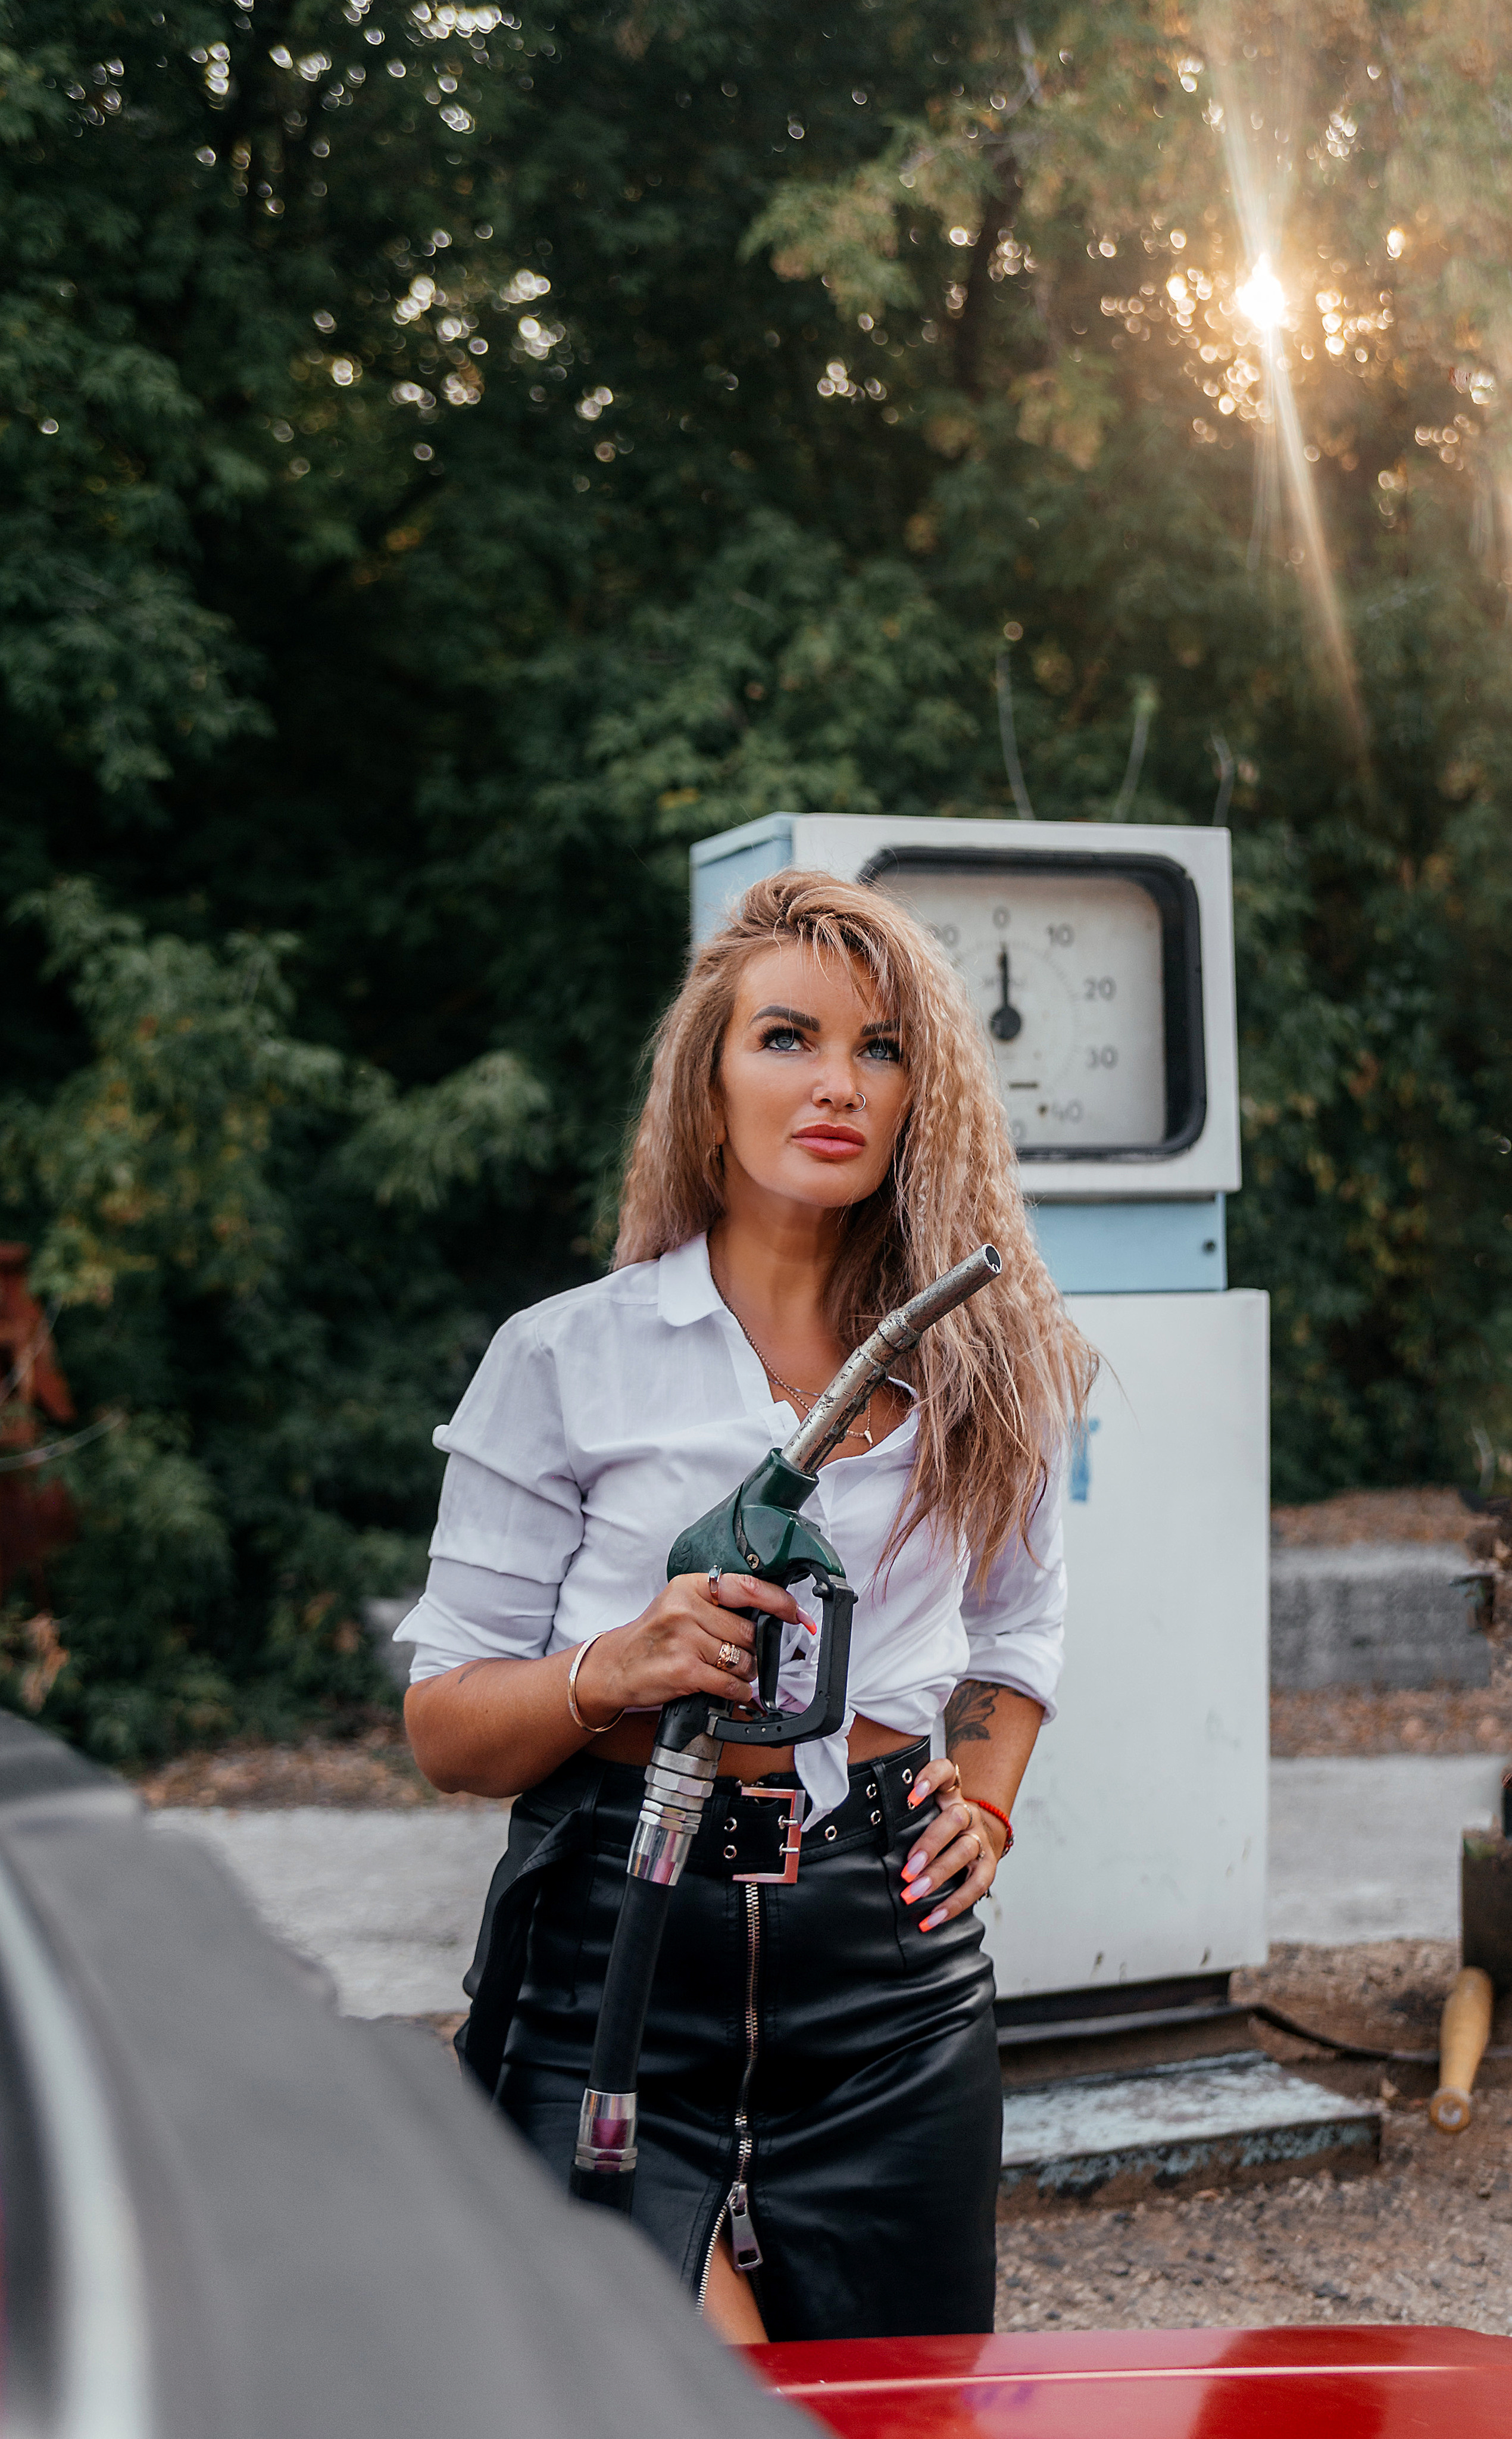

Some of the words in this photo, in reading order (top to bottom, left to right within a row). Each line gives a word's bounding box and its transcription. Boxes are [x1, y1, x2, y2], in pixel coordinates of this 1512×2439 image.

[1046, 922, 1075, 948] 10
[1082, 975, 1117, 1002] 20
[1086, 1044, 1119, 1070] 30
